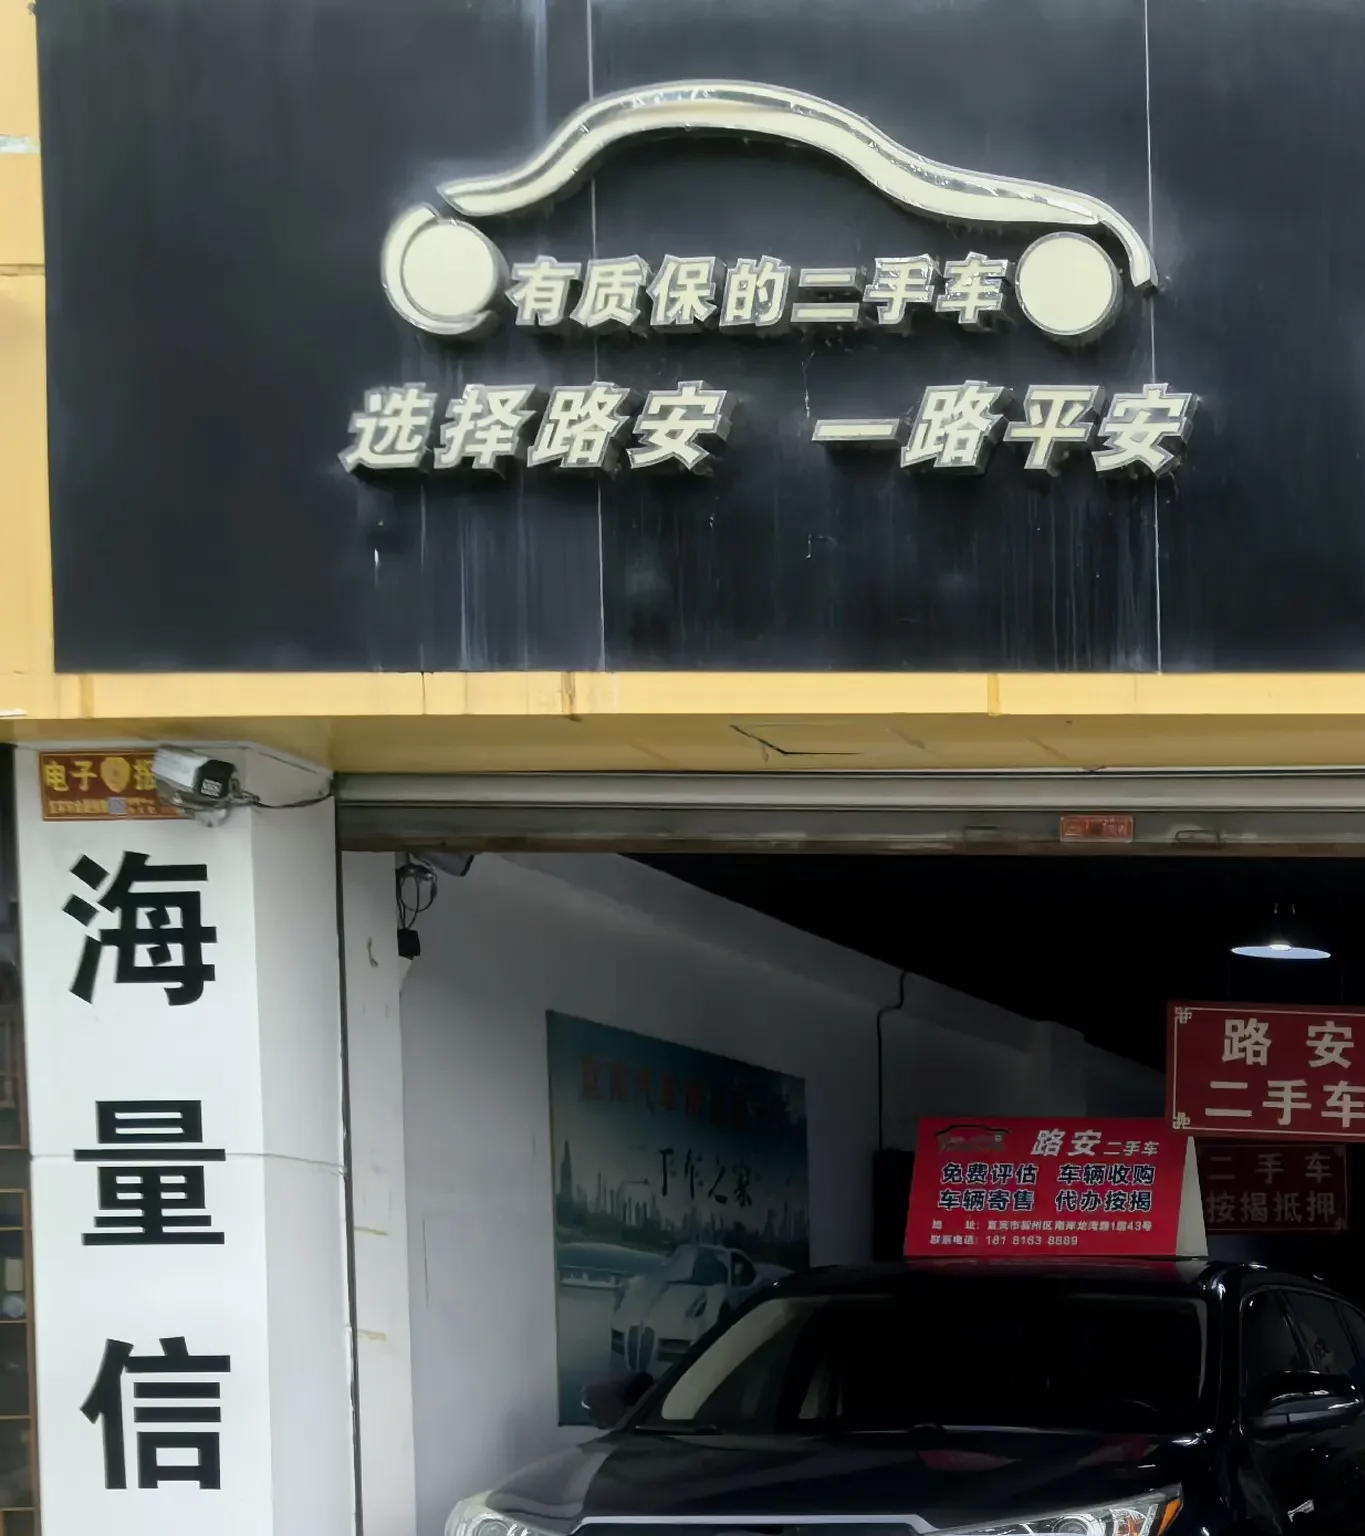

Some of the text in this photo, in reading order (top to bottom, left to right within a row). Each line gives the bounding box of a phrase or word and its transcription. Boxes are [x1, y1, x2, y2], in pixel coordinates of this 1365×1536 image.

[506, 252, 1010, 332] 有质保的二手车
[340, 380, 1197, 476] 选择路安 一路平安
[1221, 1017, 1355, 1069] 路安
[940, 1162, 1156, 1185] 免费评估 车辆收购
[1206, 1152, 1333, 1184] 二手车
[937, 1189, 1151, 1212] 车辆寄售 代办按揭
